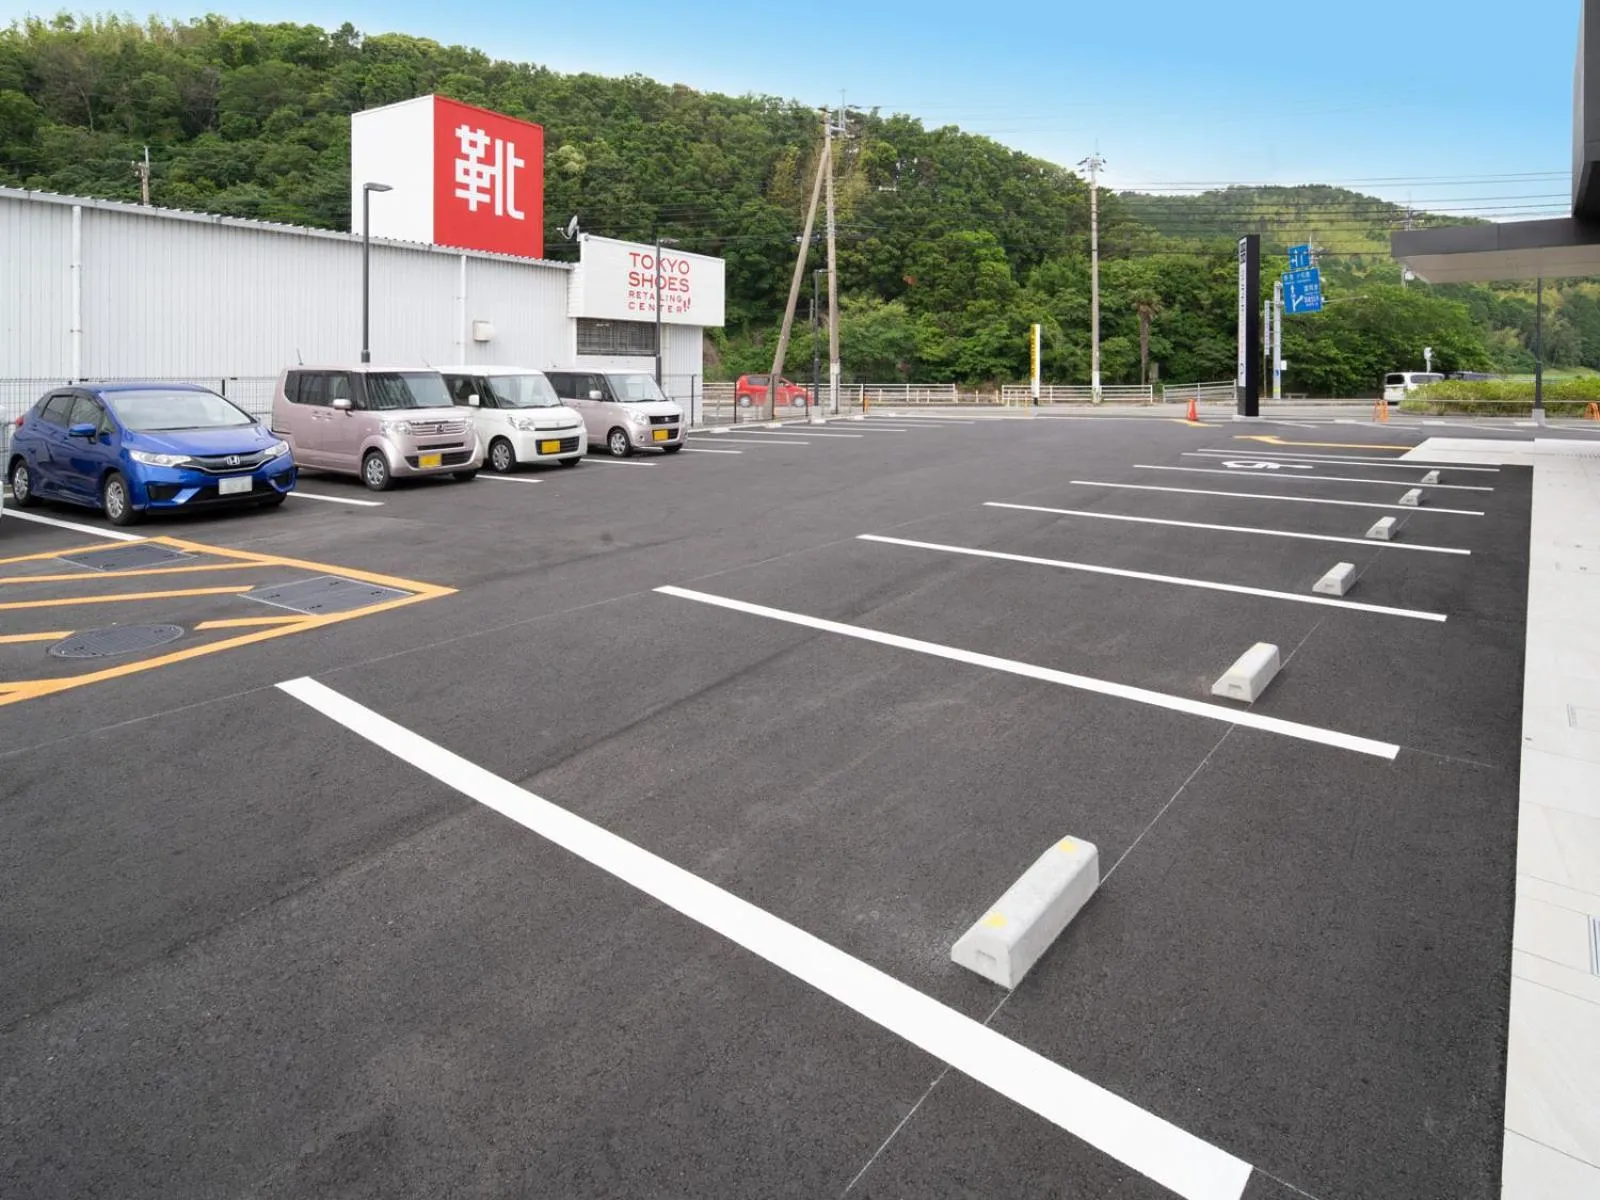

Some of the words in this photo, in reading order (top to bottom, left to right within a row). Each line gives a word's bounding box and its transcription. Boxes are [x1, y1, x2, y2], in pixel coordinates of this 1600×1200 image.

[455, 124, 525, 220] 靴
[628, 252, 690, 275] TOKYO
[628, 271, 690, 293] SHOES
[628, 290, 682, 303] RETALING
